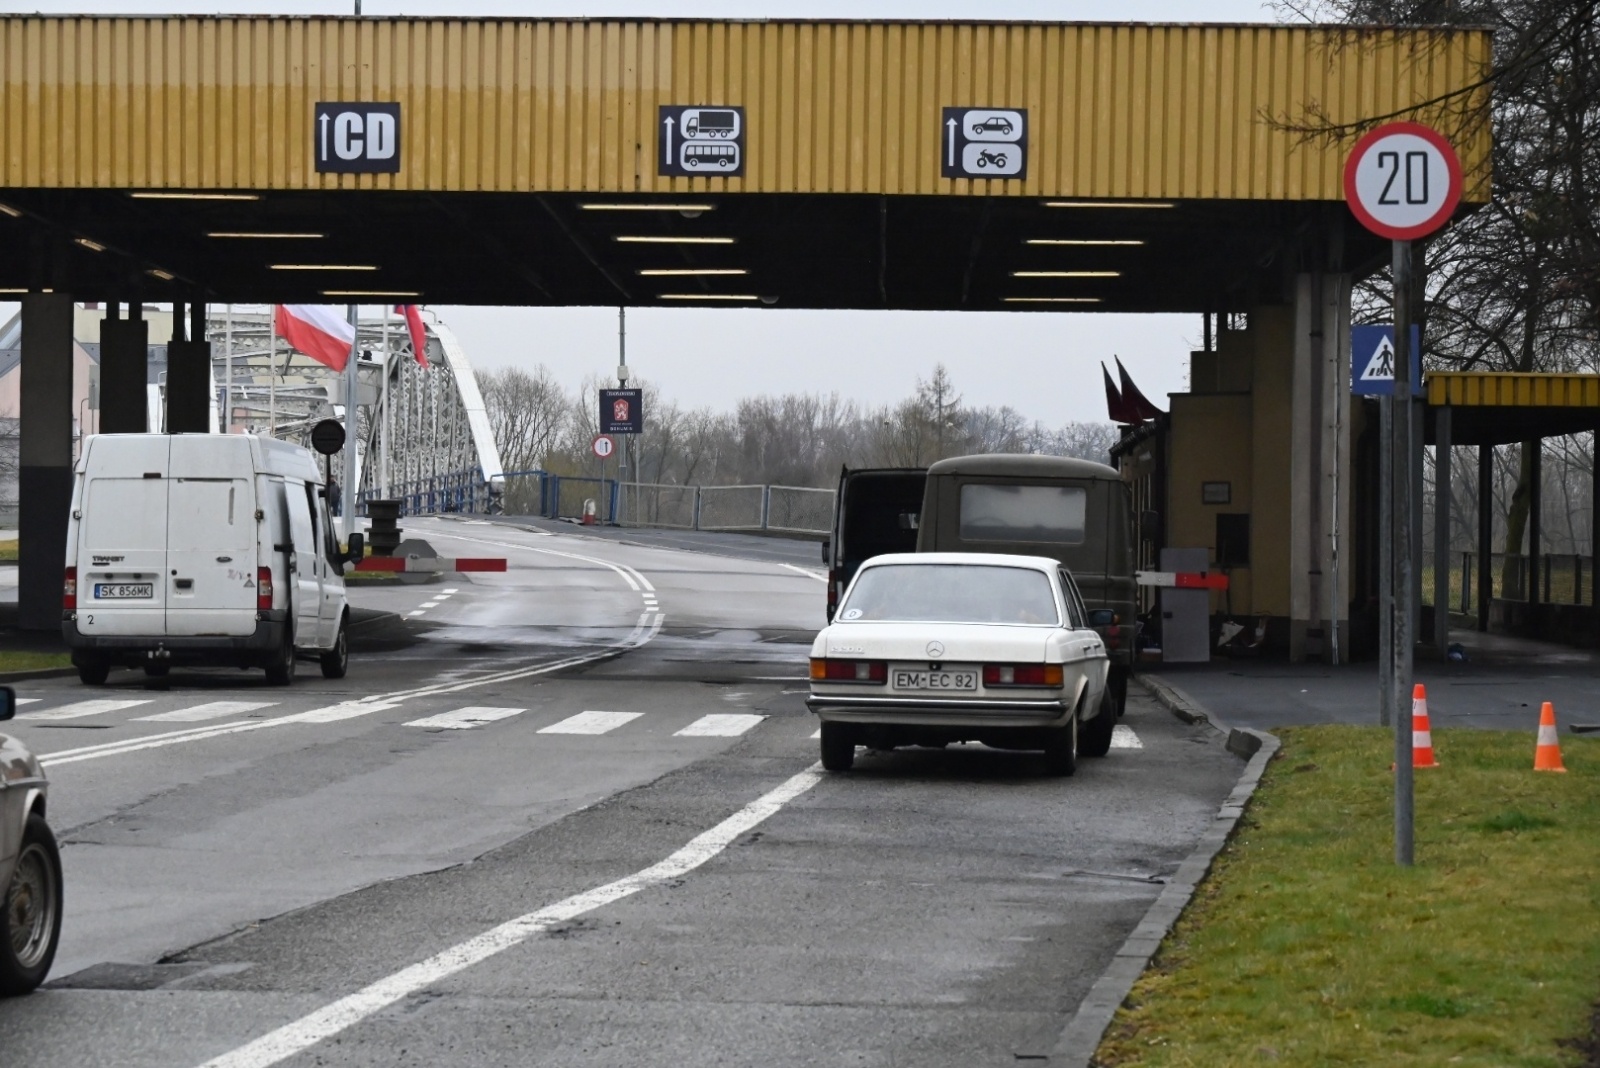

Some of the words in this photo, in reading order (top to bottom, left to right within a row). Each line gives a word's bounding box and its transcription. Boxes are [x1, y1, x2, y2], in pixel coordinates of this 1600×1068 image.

[334, 111, 395, 160] CD
[1378, 151, 1428, 205] 20
[102, 586, 115, 596] SK
[119, 586, 150, 596] 856MK
[87, 615, 95, 625] 2
[955, 674, 973, 688] 82
